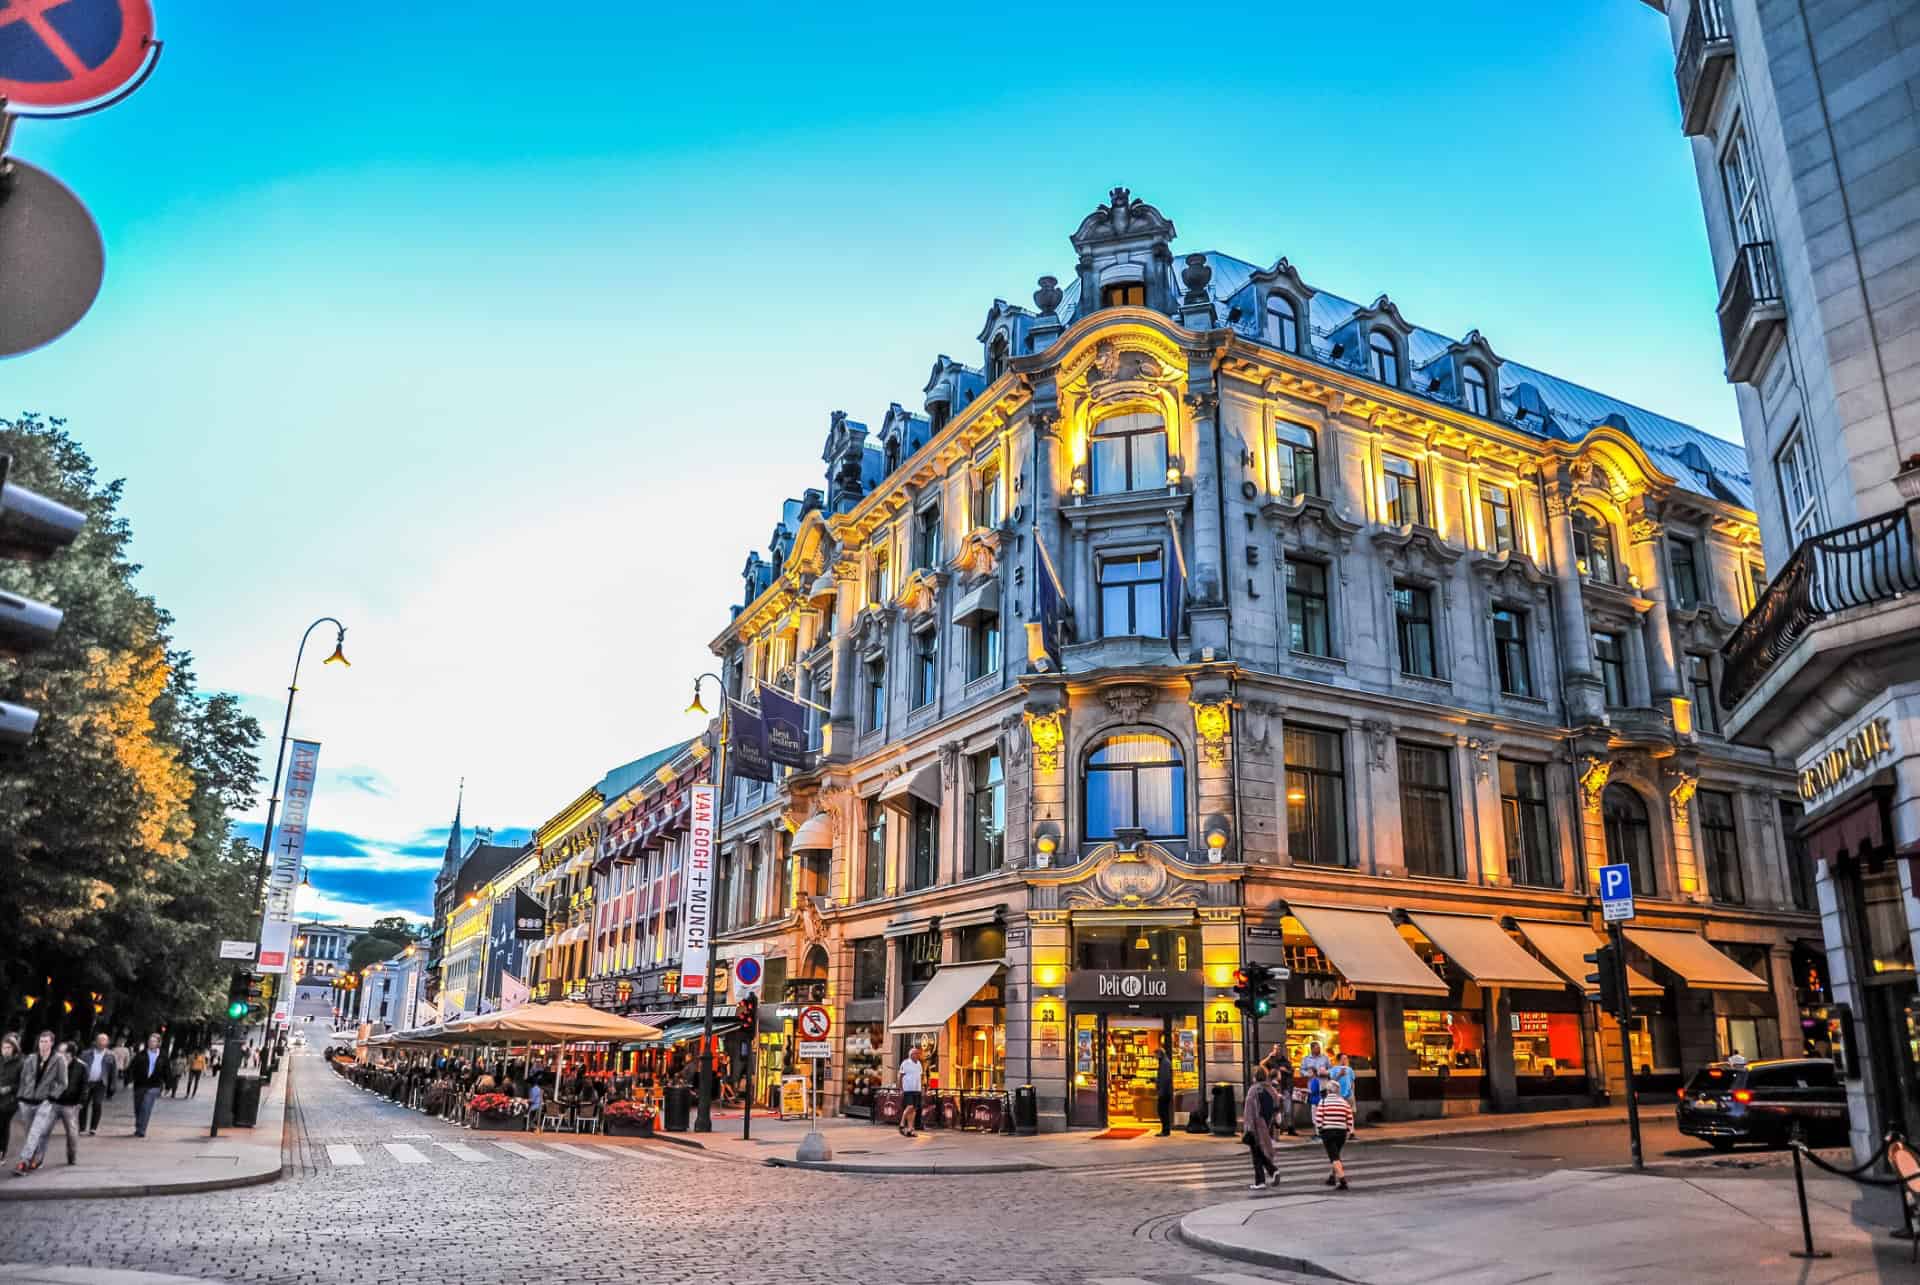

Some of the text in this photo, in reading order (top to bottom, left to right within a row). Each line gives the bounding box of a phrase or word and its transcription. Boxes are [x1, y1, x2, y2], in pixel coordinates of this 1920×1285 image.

[1240, 448, 1260, 600] HOTEL
[1013, 474, 1024, 618] HOTEL
[694, 793, 711, 821] VAN
[693, 828, 710, 869] GOGH
[1606, 870, 1622, 897] P
[687, 889, 707, 948] MUNCH
[1099, 974, 1120, 996] Deli
[1143, 974, 1167, 996] Luca
[1215, 1010, 1229, 1023] 33
